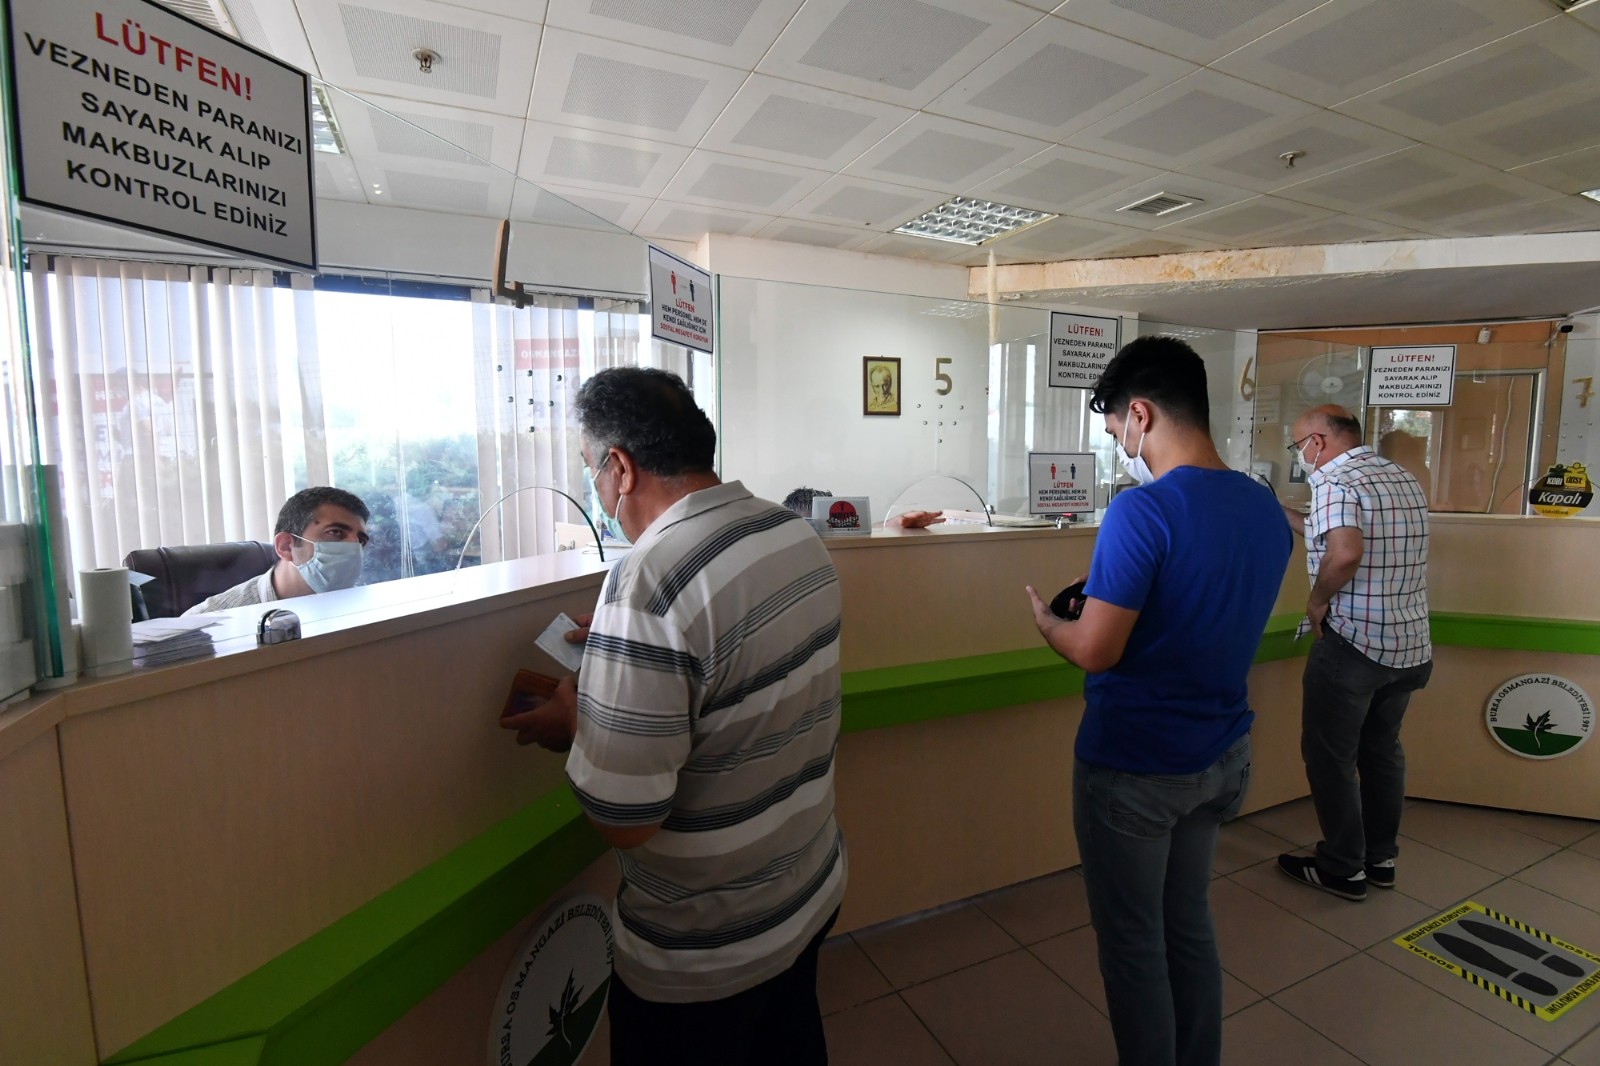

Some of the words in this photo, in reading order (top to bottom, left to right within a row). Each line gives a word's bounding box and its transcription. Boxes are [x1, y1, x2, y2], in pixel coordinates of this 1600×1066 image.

[95, 11, 252, 101] LÜTFEN!
[24, 31, 189, 112] VEZNEDEN
[198, 100, 302, 155] PARANIZI
[80, 91, 214, 154] SAYARAK
[219, 142, 271, 171] ALIP
[61, 120, 287, 207] MAKBUZLARINIZI
[66, 159, 207, 215] KONTROL
[213, 201, 288, 237] EDİNİZ
[675, 298, 695, 313] LÜTFEN
[1053, 337, 1087, 347] VEZNEDEN
[1087, 341, 1115, 350] PARANIZI
[1067, 323, 1104, 337] LÜTFEN!
[1062, 349, 1091, 358] SAYARAK
[1390, 353, 1435, 363] LÜTFEN!
[935, 357, 953, 396] 5
[1057, 371, 1087, 380] KONTROL
[1240, 356, 1256, 402] 6
[1572, 376, 1596, 408] 7
[1053, 481, 1074, 489] LÜTFEN
[1537, 491, 1583, 506] Kapalı
[1489, 698, 1502, 723] BURSA
[1498, 677, 1551, 699] OSMANGAZİ
[1551, 679, 1591, 716] BELEDİYESİ
[506, 912, 566, 1015] OSMANGAZİ
[1407, 943, 1455, 970] SOSYAL
[1556, 940, 1600, 962] SOSYA
[500, 1016, 513, 1066] URSA
